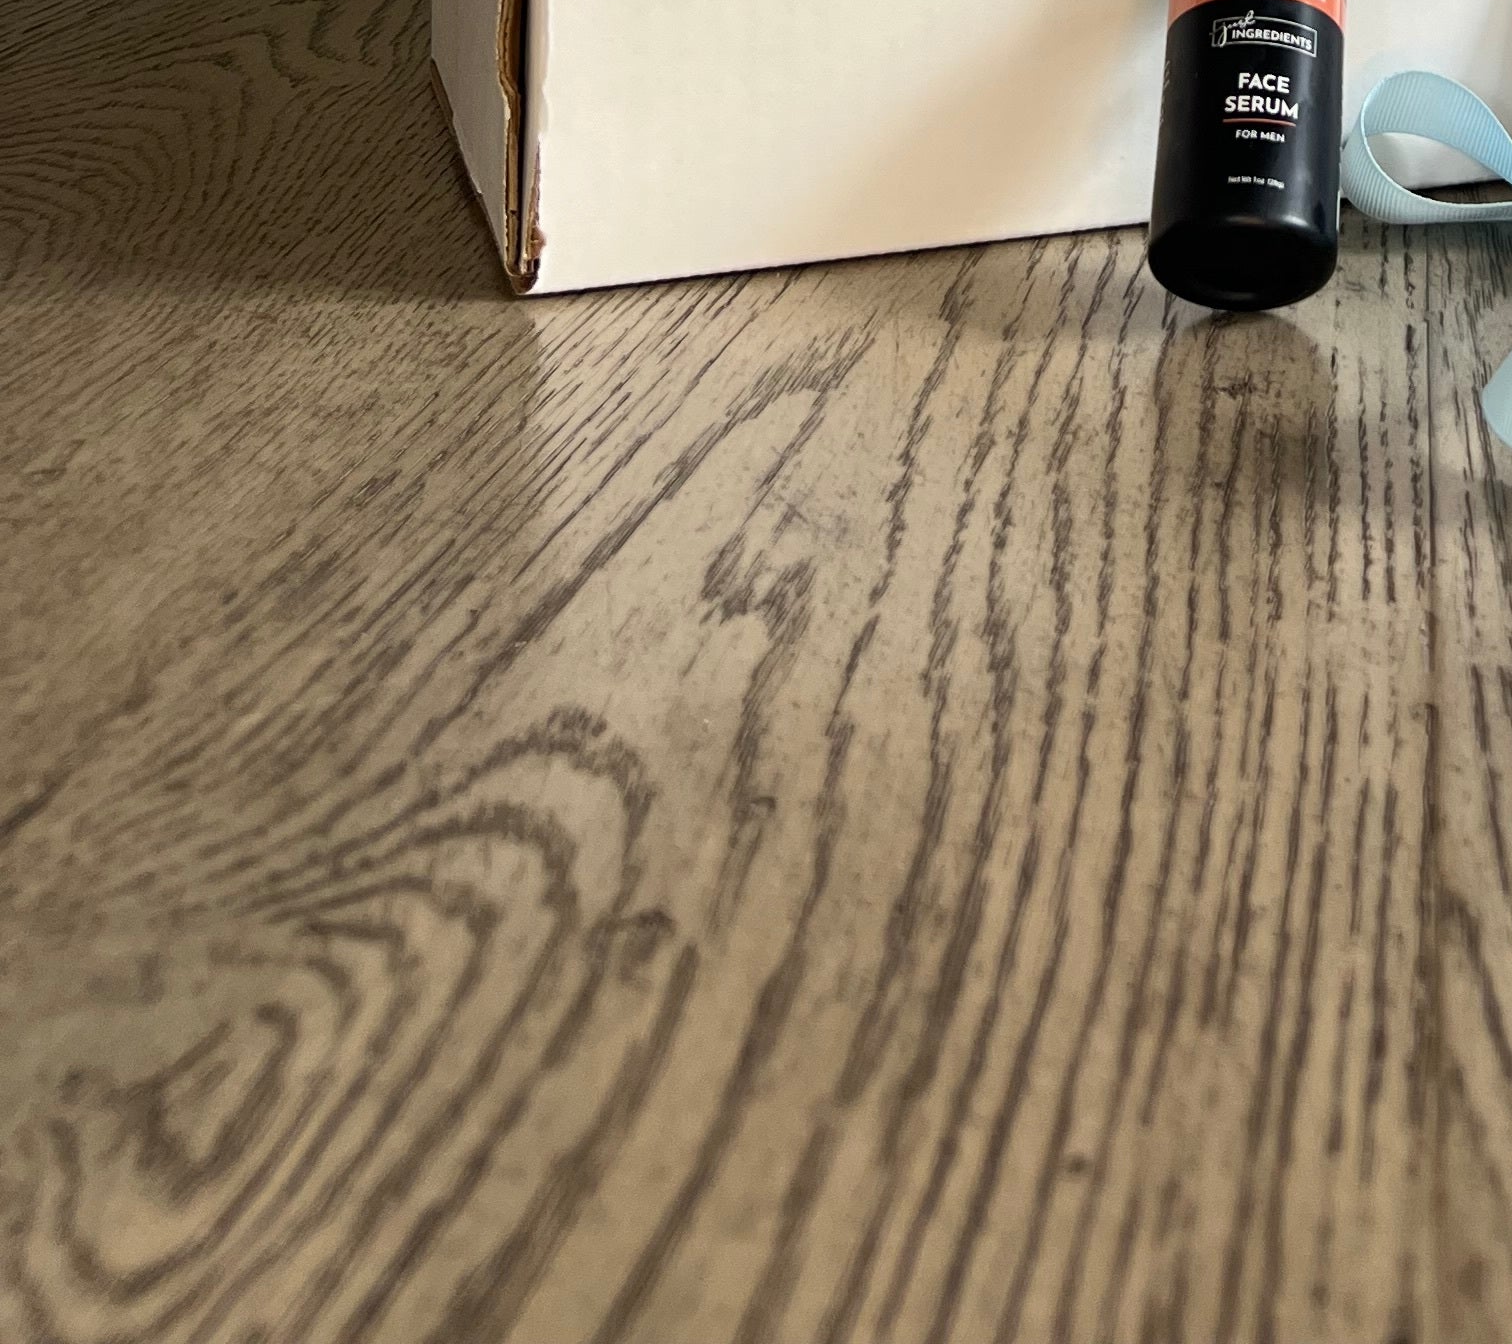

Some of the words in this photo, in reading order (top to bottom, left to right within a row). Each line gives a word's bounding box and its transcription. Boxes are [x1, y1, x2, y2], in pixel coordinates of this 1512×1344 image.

[1231, 28, 1312, 51] INGREDIENTS
[1238, 72, 1290, 94] FACE
[1224, 95, 1299, 120] SERUM
[1235, 129, 1258, 139] FOR
[1260, 131, 1285, 143] MEN
